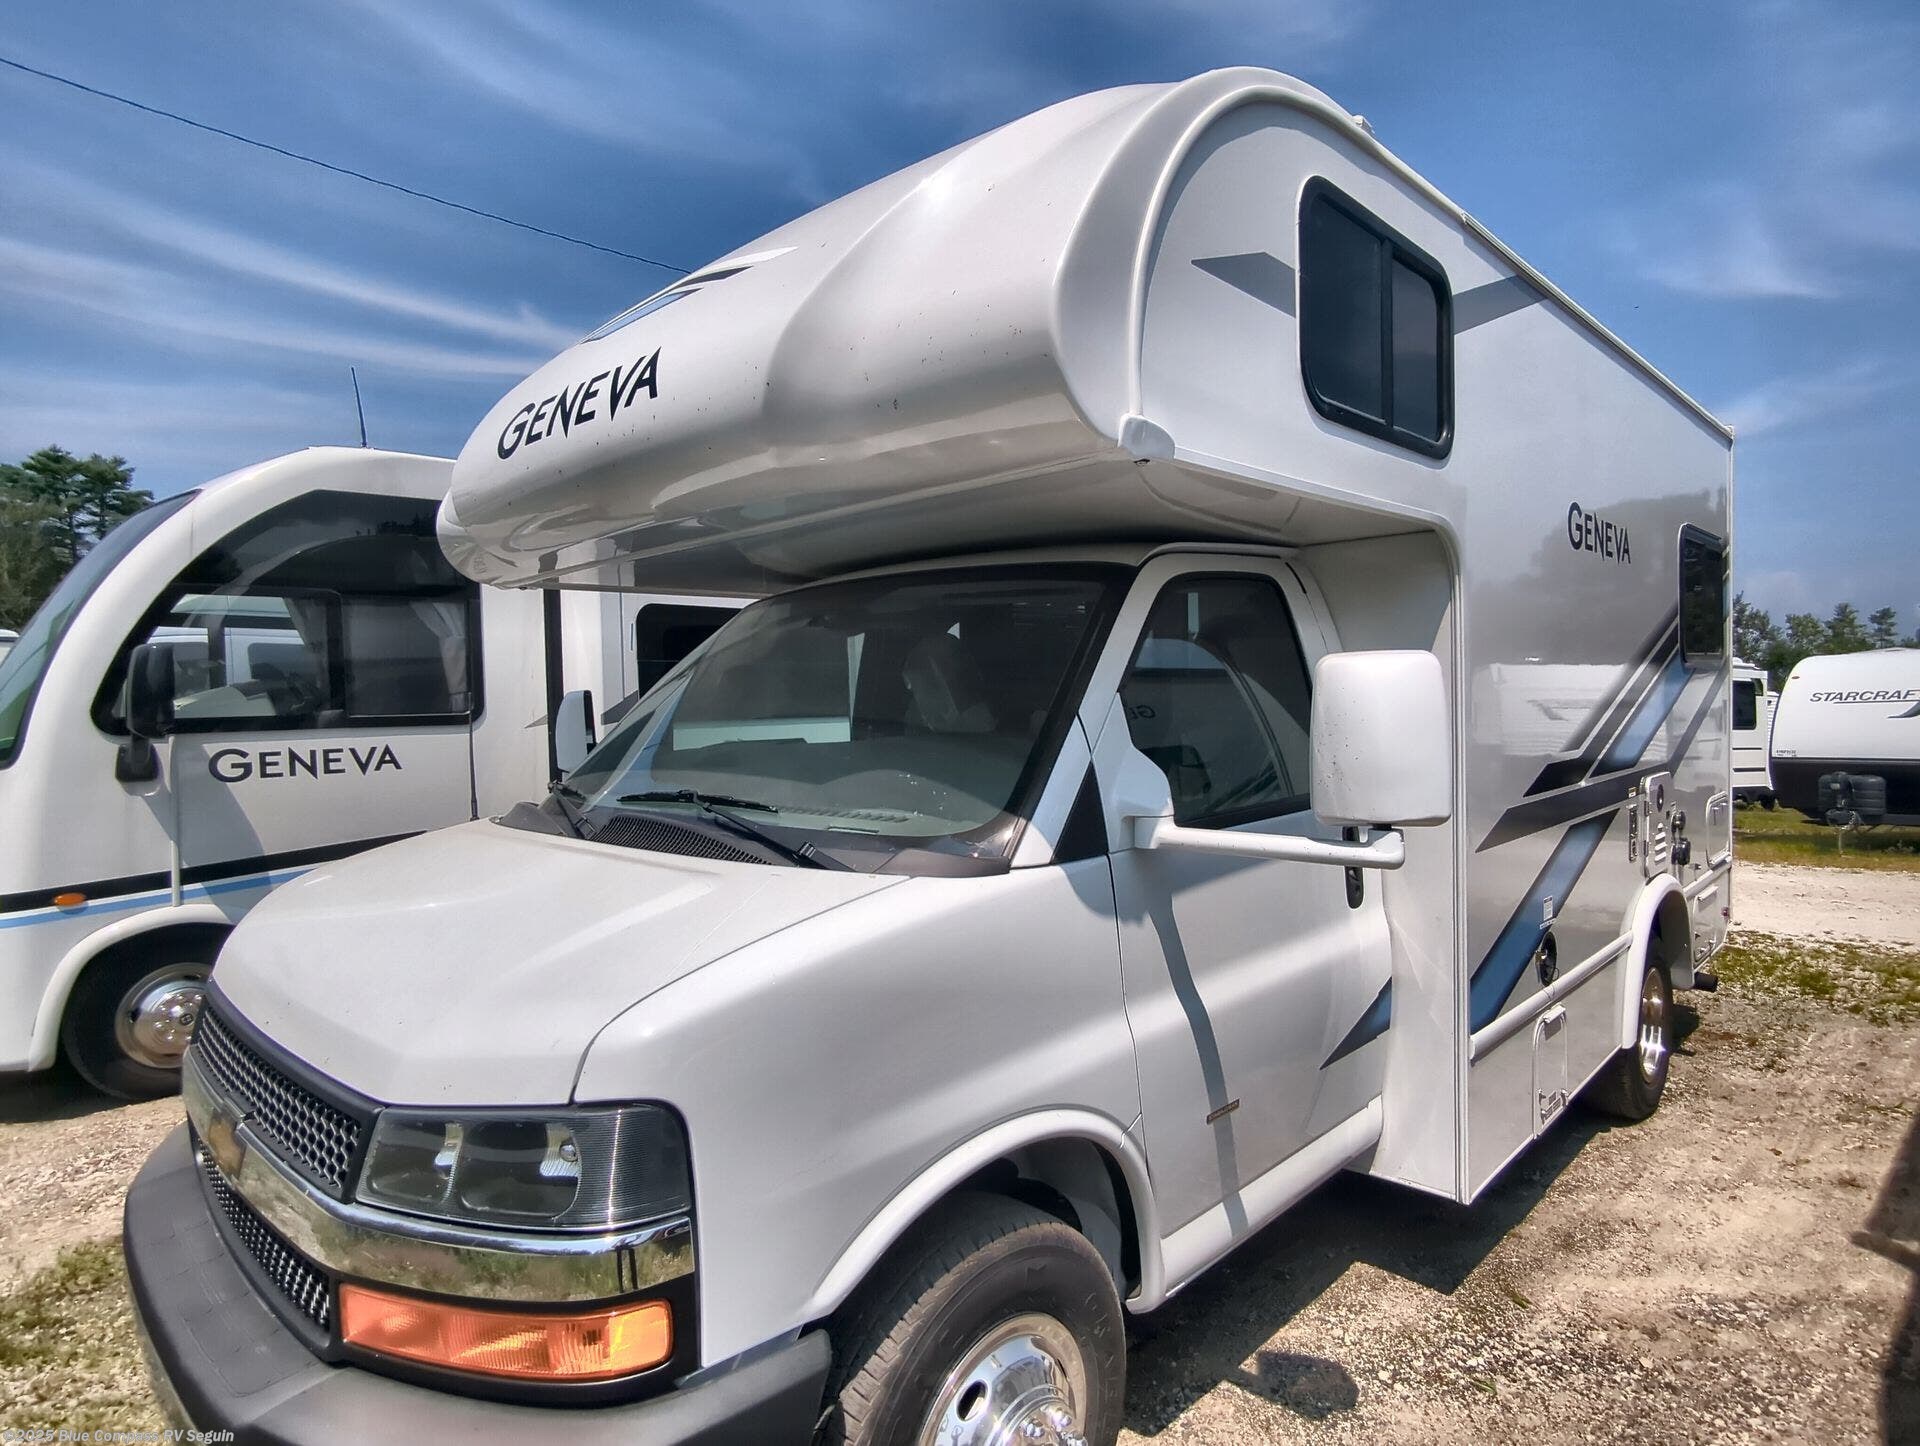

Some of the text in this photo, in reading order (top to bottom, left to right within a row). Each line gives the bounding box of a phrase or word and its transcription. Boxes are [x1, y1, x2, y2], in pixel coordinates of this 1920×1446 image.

[497, 346, 661, 460] GENEVA
[1567, 501, 1631, 565] GENEVA
[1809, 689, 1920, 702] STARCRAF
[208, 743, 402, 783] GENEVA
